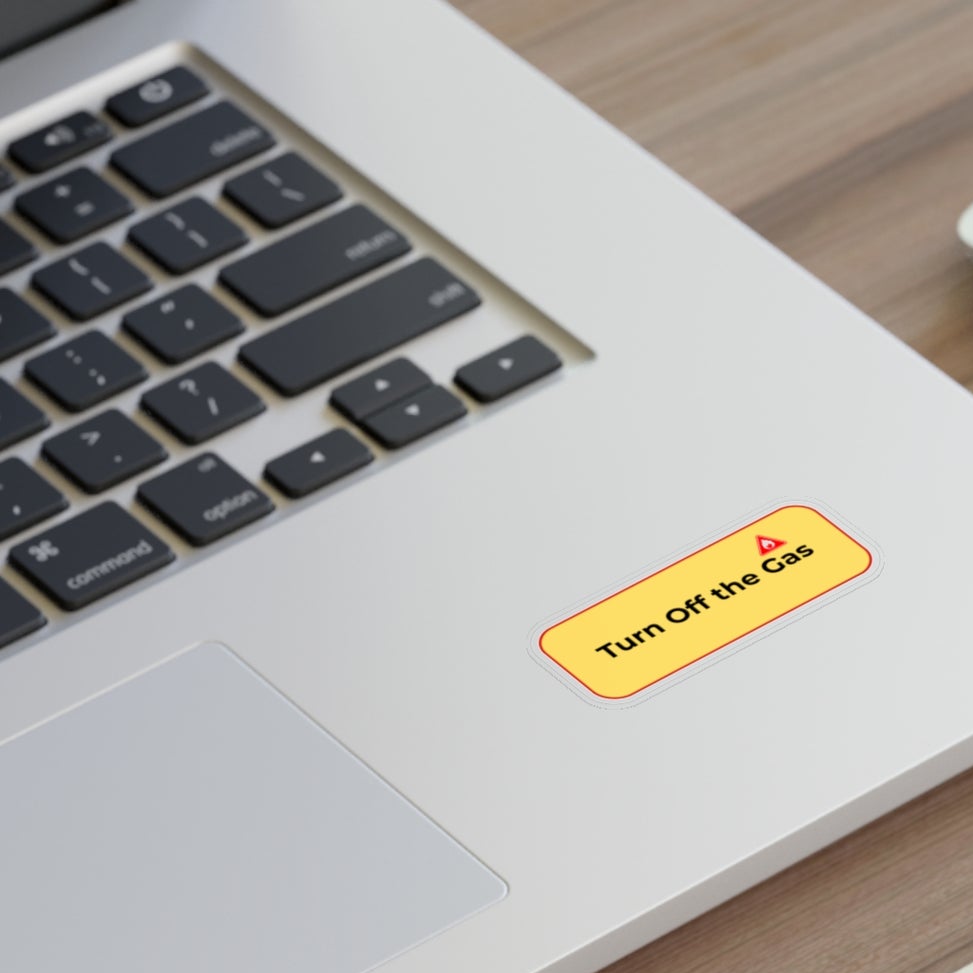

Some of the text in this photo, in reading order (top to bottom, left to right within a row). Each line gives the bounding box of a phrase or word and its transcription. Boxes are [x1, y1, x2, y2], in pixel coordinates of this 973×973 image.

[203, 489, 258, 522] option
[66, 538, 153, 590] command
[595, 544, 814, 658] Turn Off the Gas
